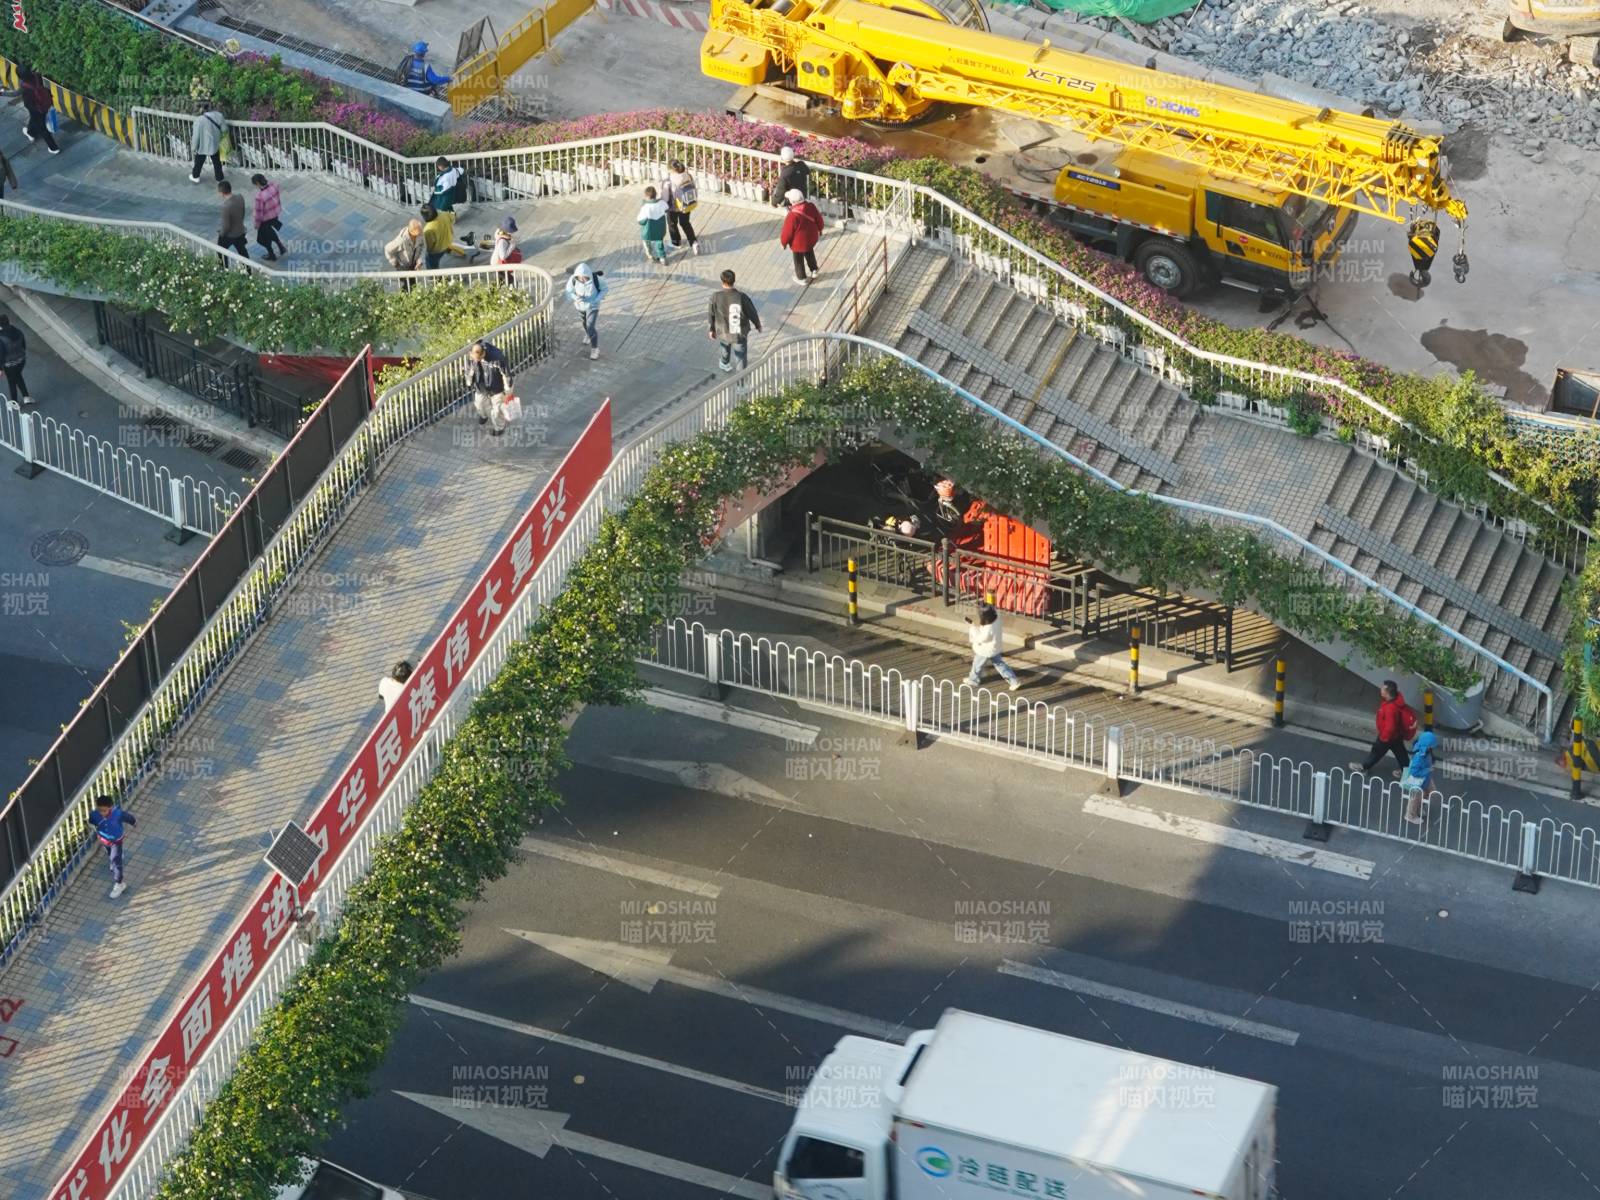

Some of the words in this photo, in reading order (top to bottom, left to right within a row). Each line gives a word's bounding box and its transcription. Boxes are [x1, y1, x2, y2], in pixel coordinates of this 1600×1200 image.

[1026, 67, 1097, 93] XCT25
[958, 1156, 1067, 1199] 冷链配送
